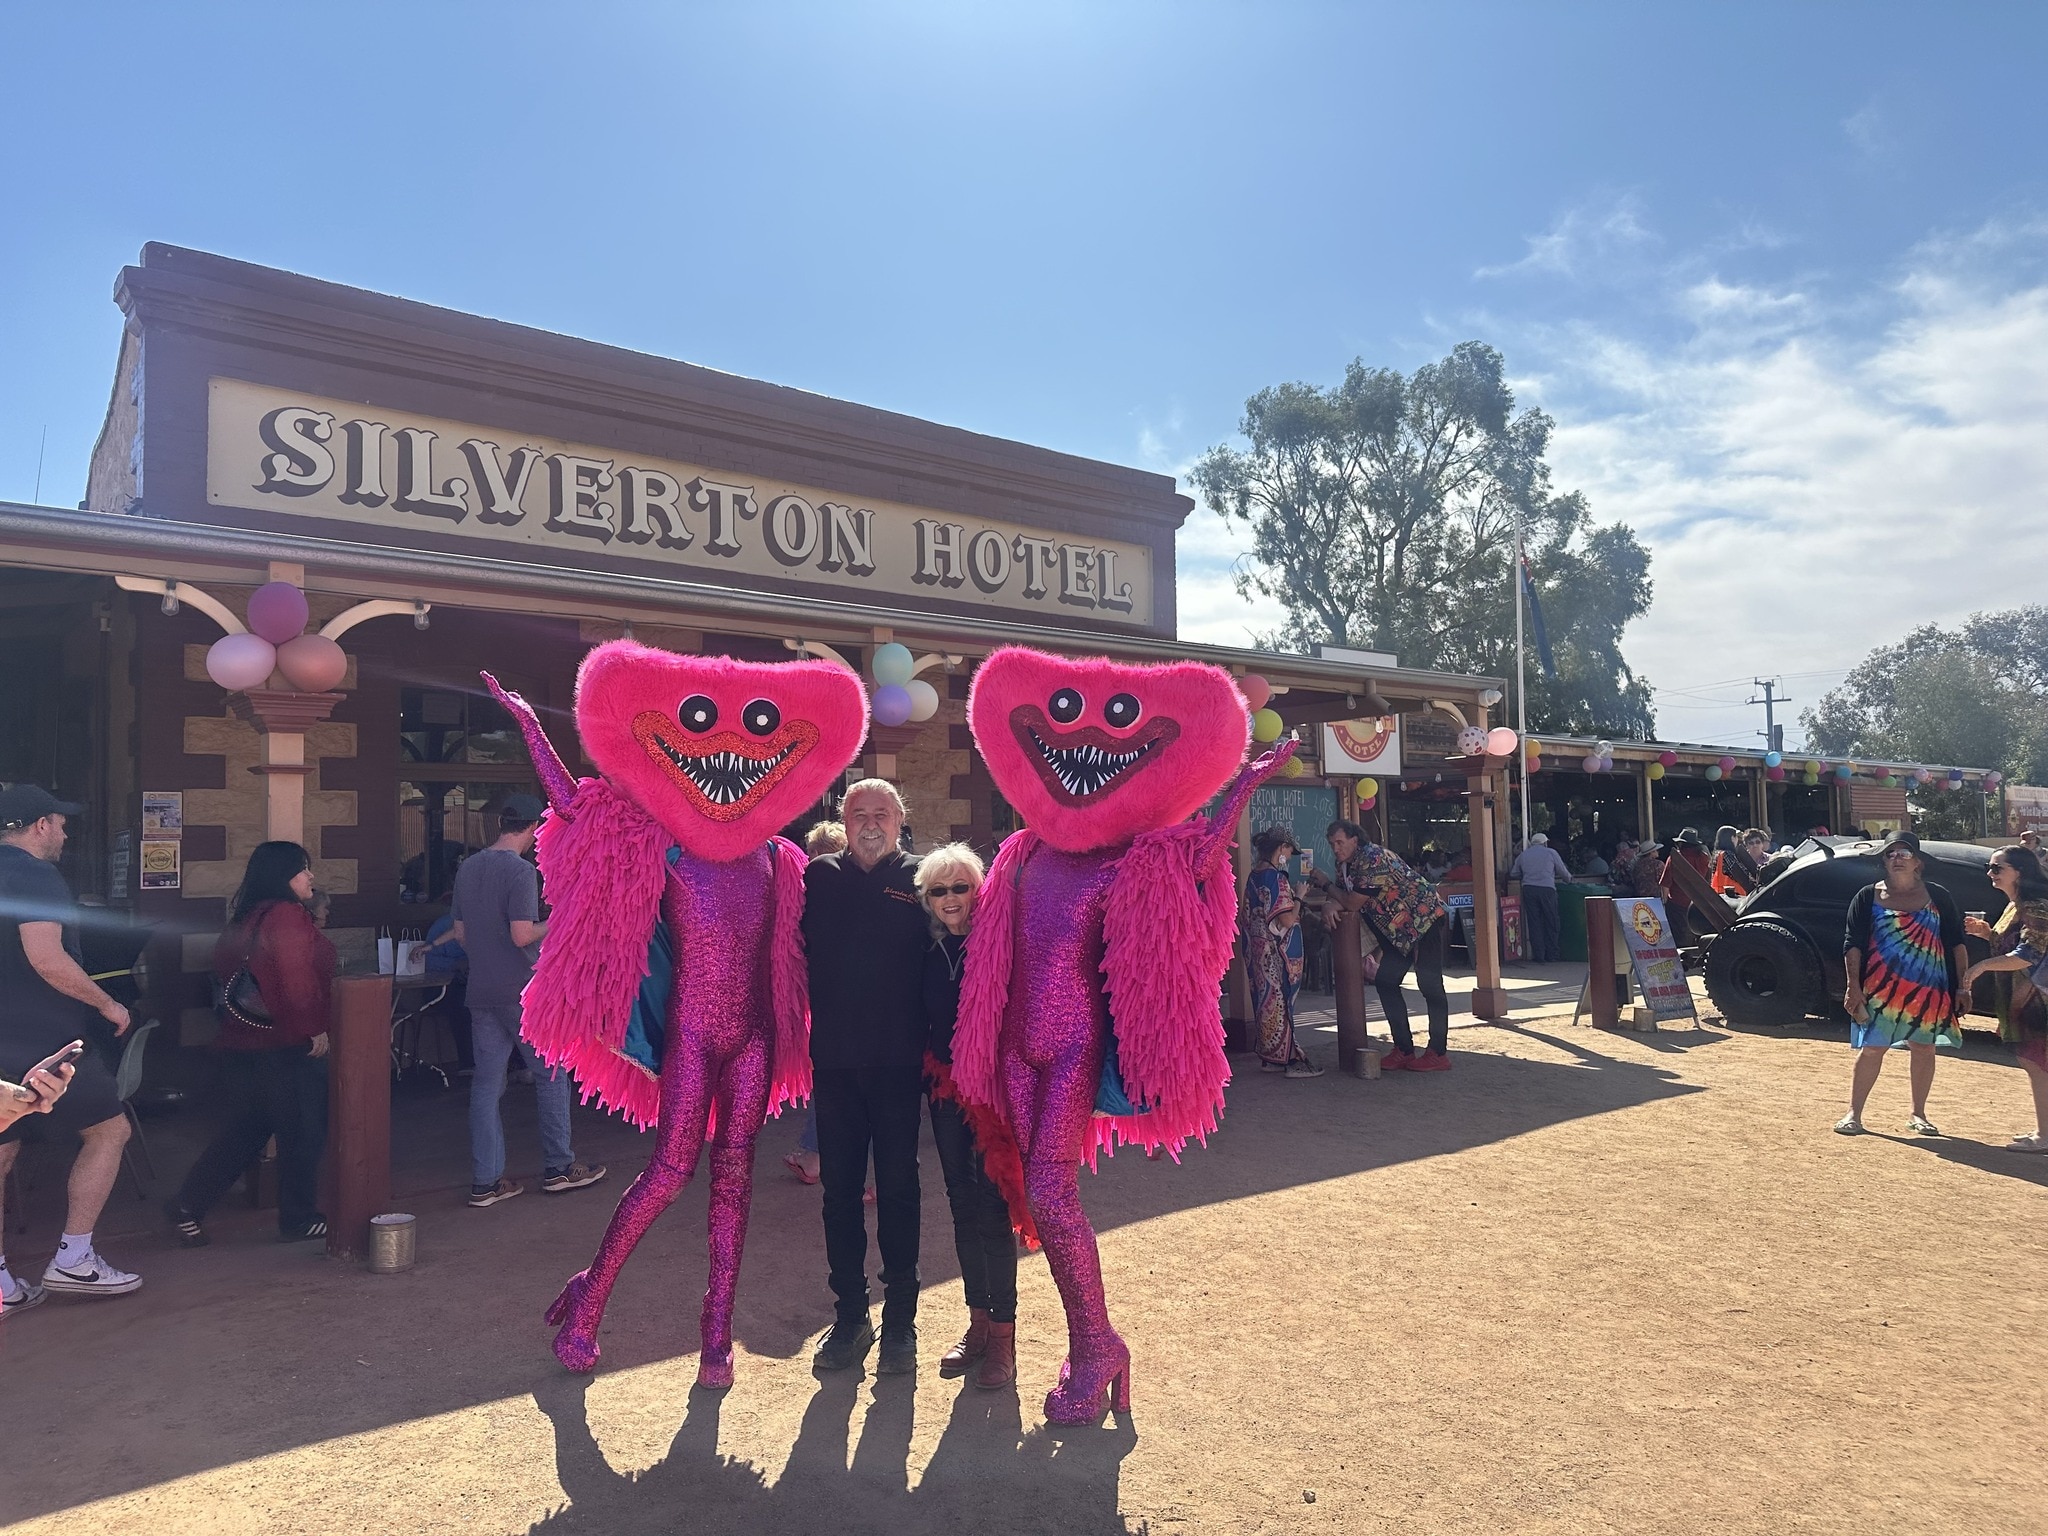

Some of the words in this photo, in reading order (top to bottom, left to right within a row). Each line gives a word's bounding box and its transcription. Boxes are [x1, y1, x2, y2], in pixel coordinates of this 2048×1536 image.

[252, 406, 876, 577] SILVERTON
[911, 518, 1133, 614] HOTEL
[1345, 736, 1382, 756] HOTEL
[1251, 788, 1277, 806] ERTON
[1283, 789, 1307, 807] HOTEL
[1271, 806, 1294, 821] MENU
[1449, 896, 1472, 905] NOTICE
